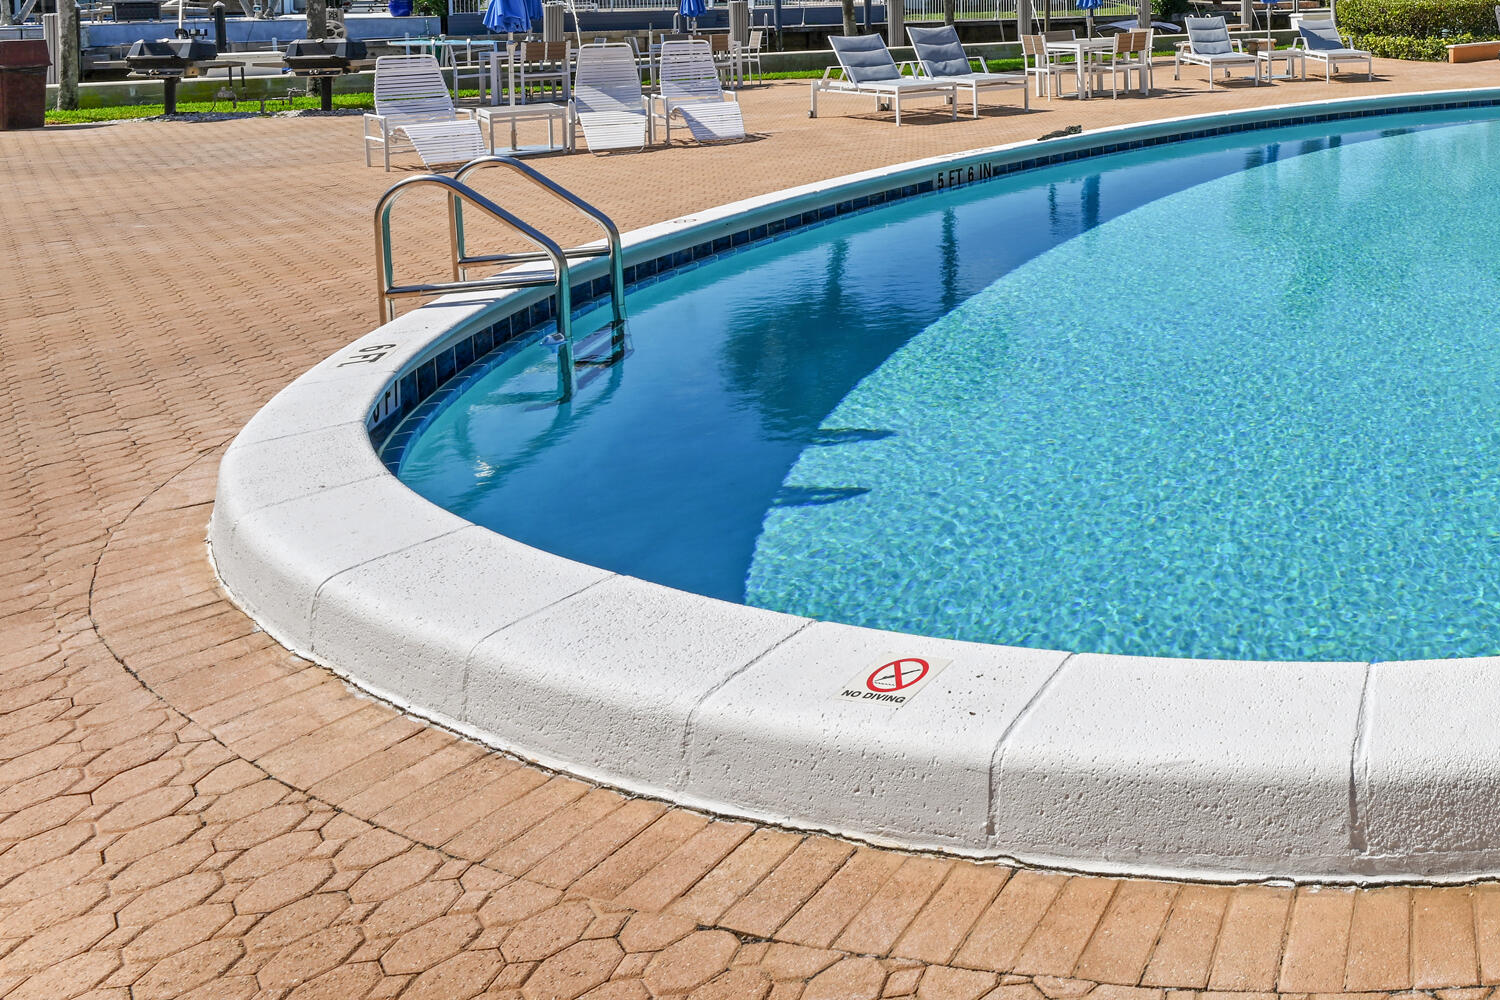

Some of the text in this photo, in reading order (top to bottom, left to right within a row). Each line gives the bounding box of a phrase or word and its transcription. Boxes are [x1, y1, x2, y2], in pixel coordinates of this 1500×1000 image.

[937, 162, 992, 189] 5 FT 6 IN
[359, 343, 397, 353] 6
[840, 689, 906, 704] NO DIVING
